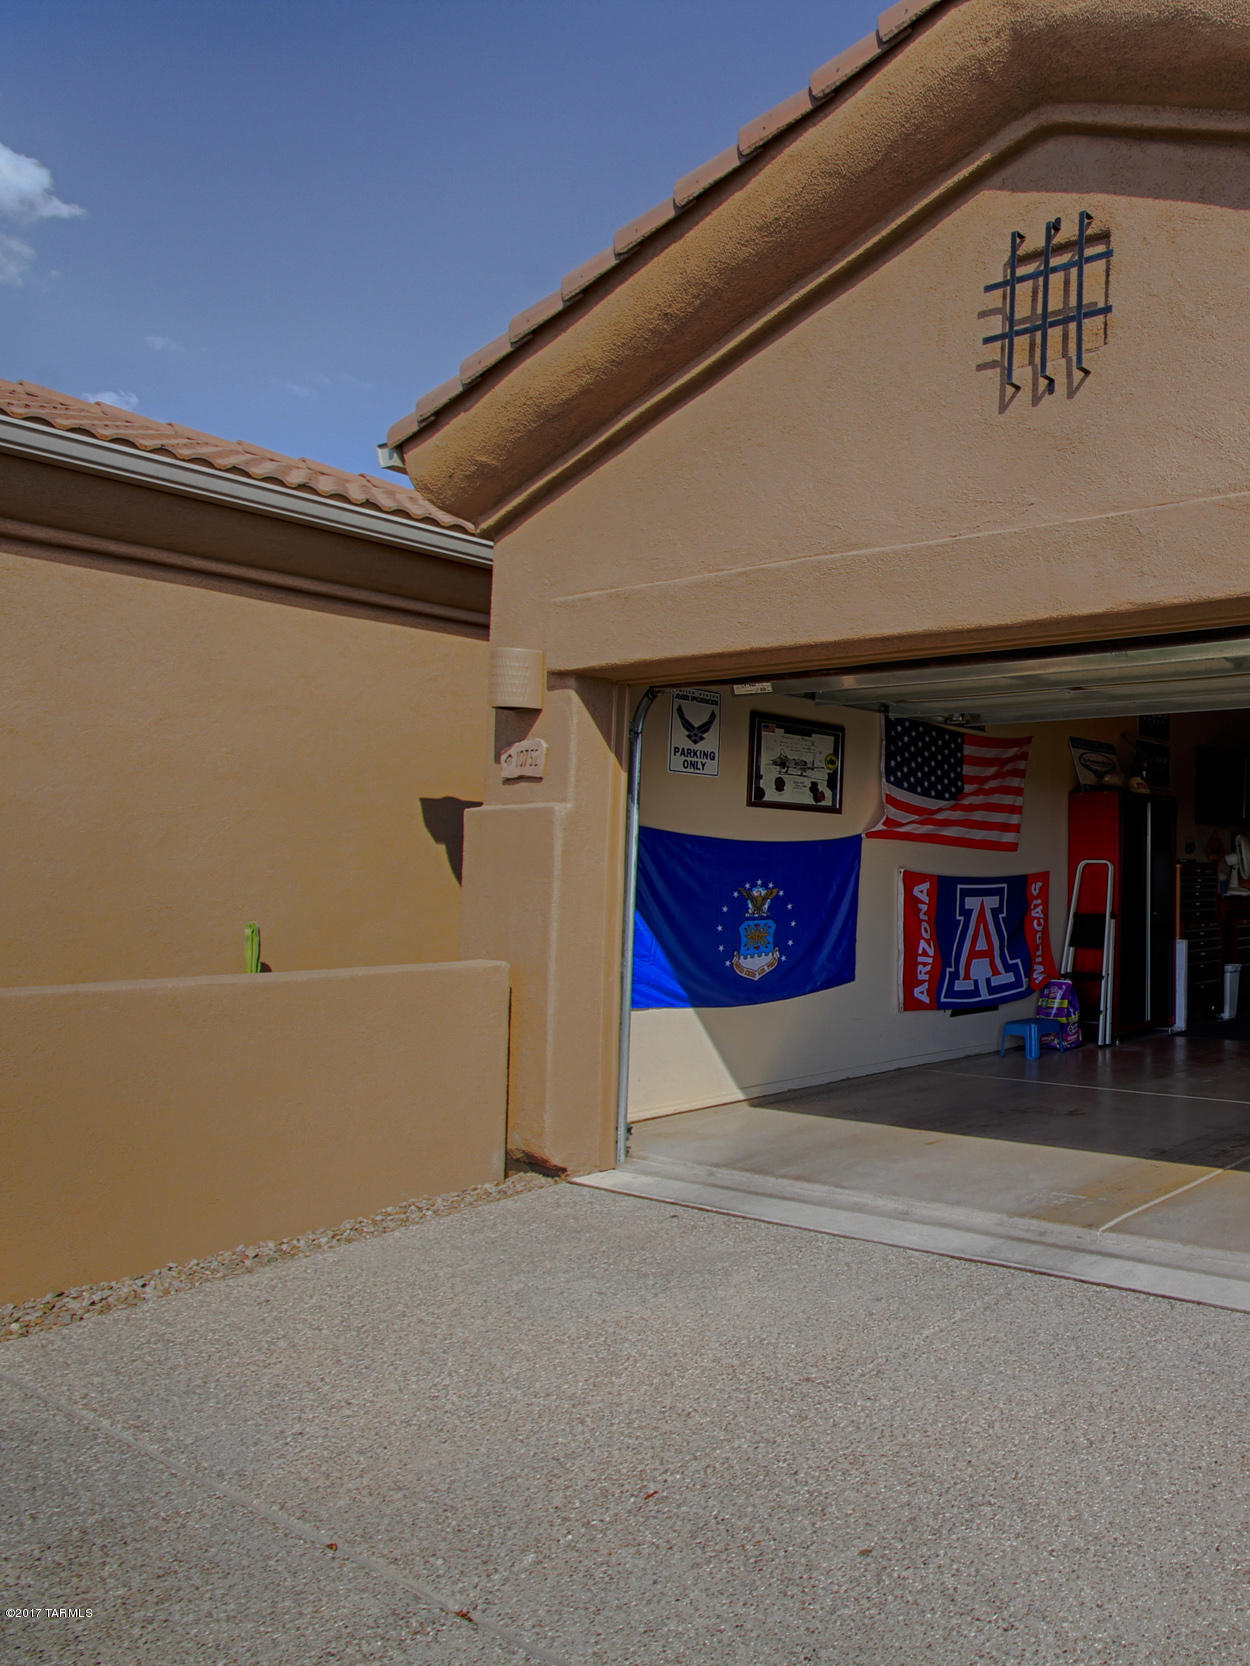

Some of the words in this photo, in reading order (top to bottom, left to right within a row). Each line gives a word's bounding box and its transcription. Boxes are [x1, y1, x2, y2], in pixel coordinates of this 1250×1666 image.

[673, 746, 716, 761] PARKING
[682, 759, 707, 771] ONLY
[912, 880, 935, 1004] ARIZONA
[940, 883, 1026, 1002] A
